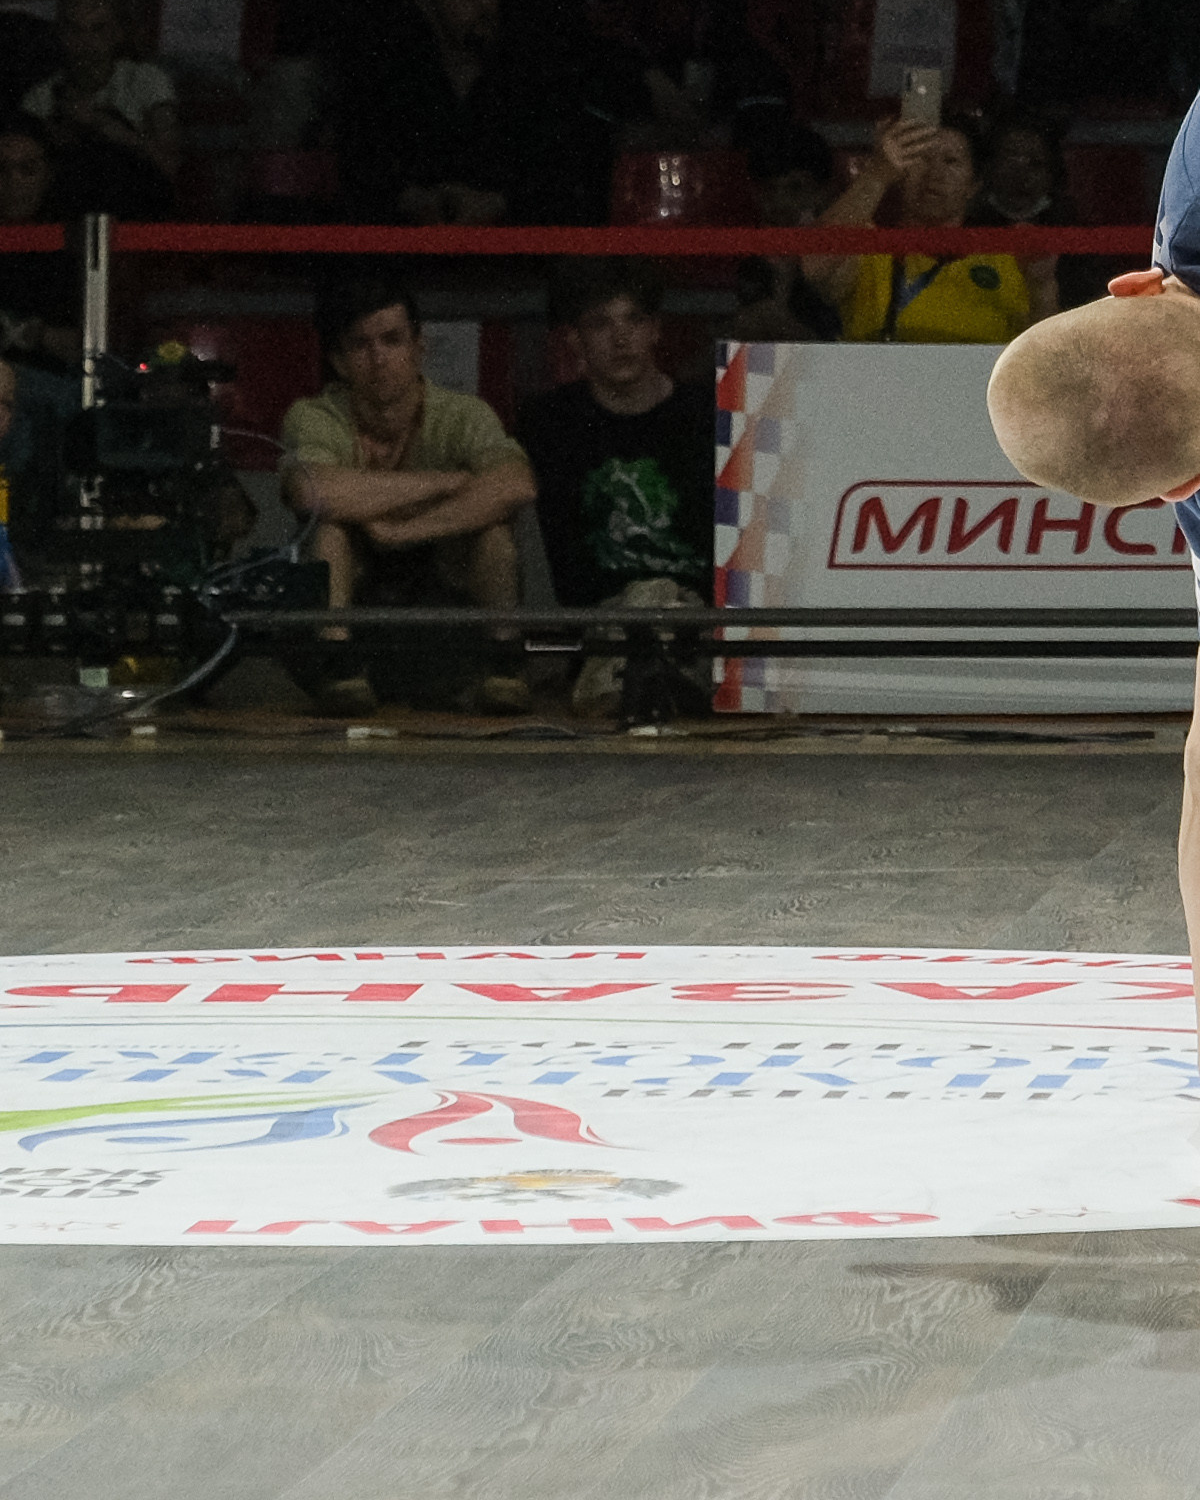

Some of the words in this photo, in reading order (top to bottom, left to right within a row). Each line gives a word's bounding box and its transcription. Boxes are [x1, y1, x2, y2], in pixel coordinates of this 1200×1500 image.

[124, 951, 648, 965] ФИНАЛ
[722, 1041, 1197, 1053] ОССИИ
[183, 1211, 940, 1235] ФИНАЛ
